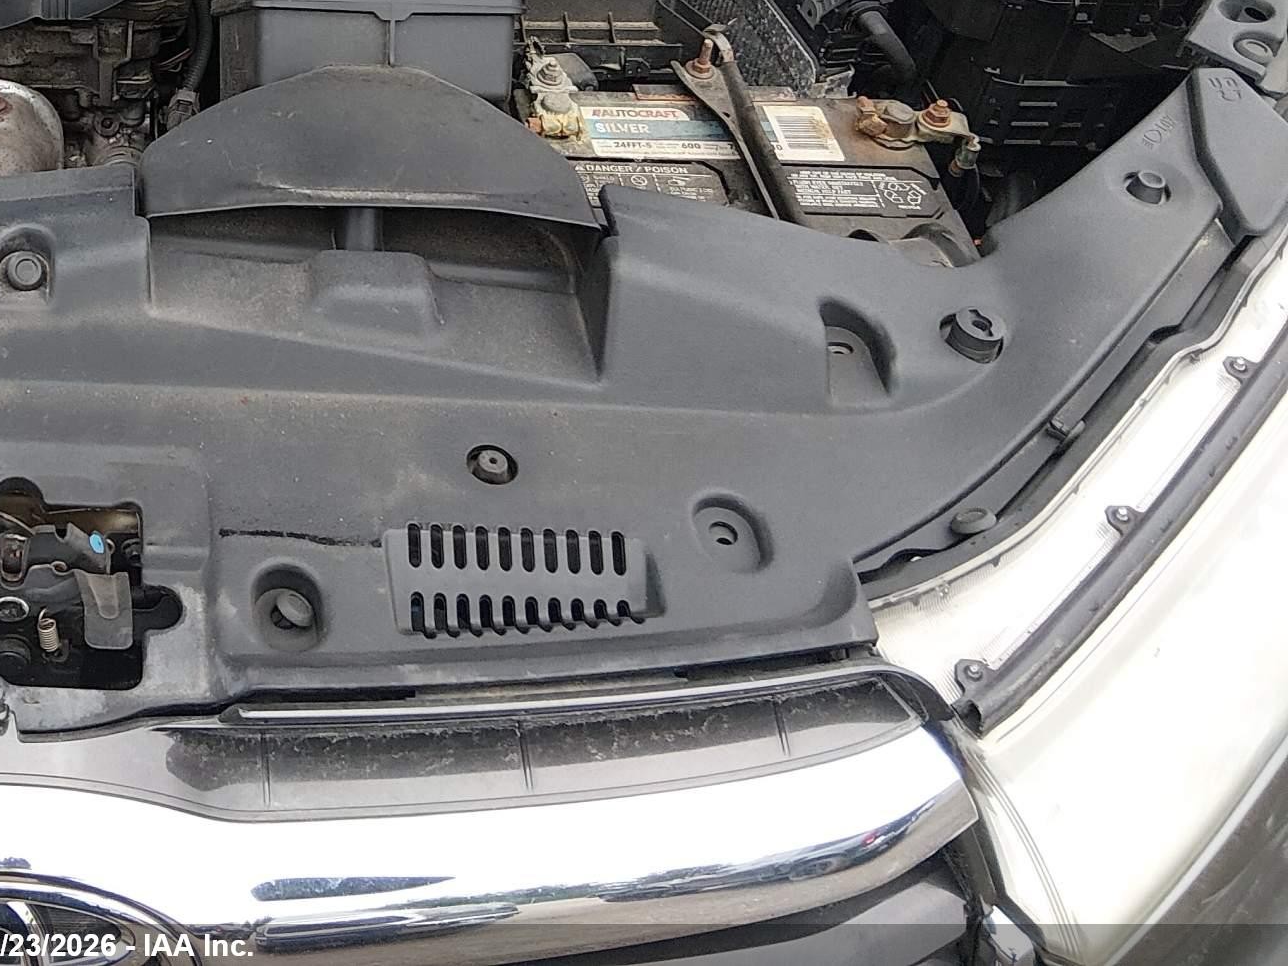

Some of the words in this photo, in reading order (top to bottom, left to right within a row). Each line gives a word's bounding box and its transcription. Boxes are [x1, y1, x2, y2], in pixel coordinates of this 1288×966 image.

[601, 109, 678, 118] AUTOCRAFT
[595, 122, 651, 134] SILVER
[585, 163, 633, 173] DANGER
[644, 165, 689, 175] POISON
